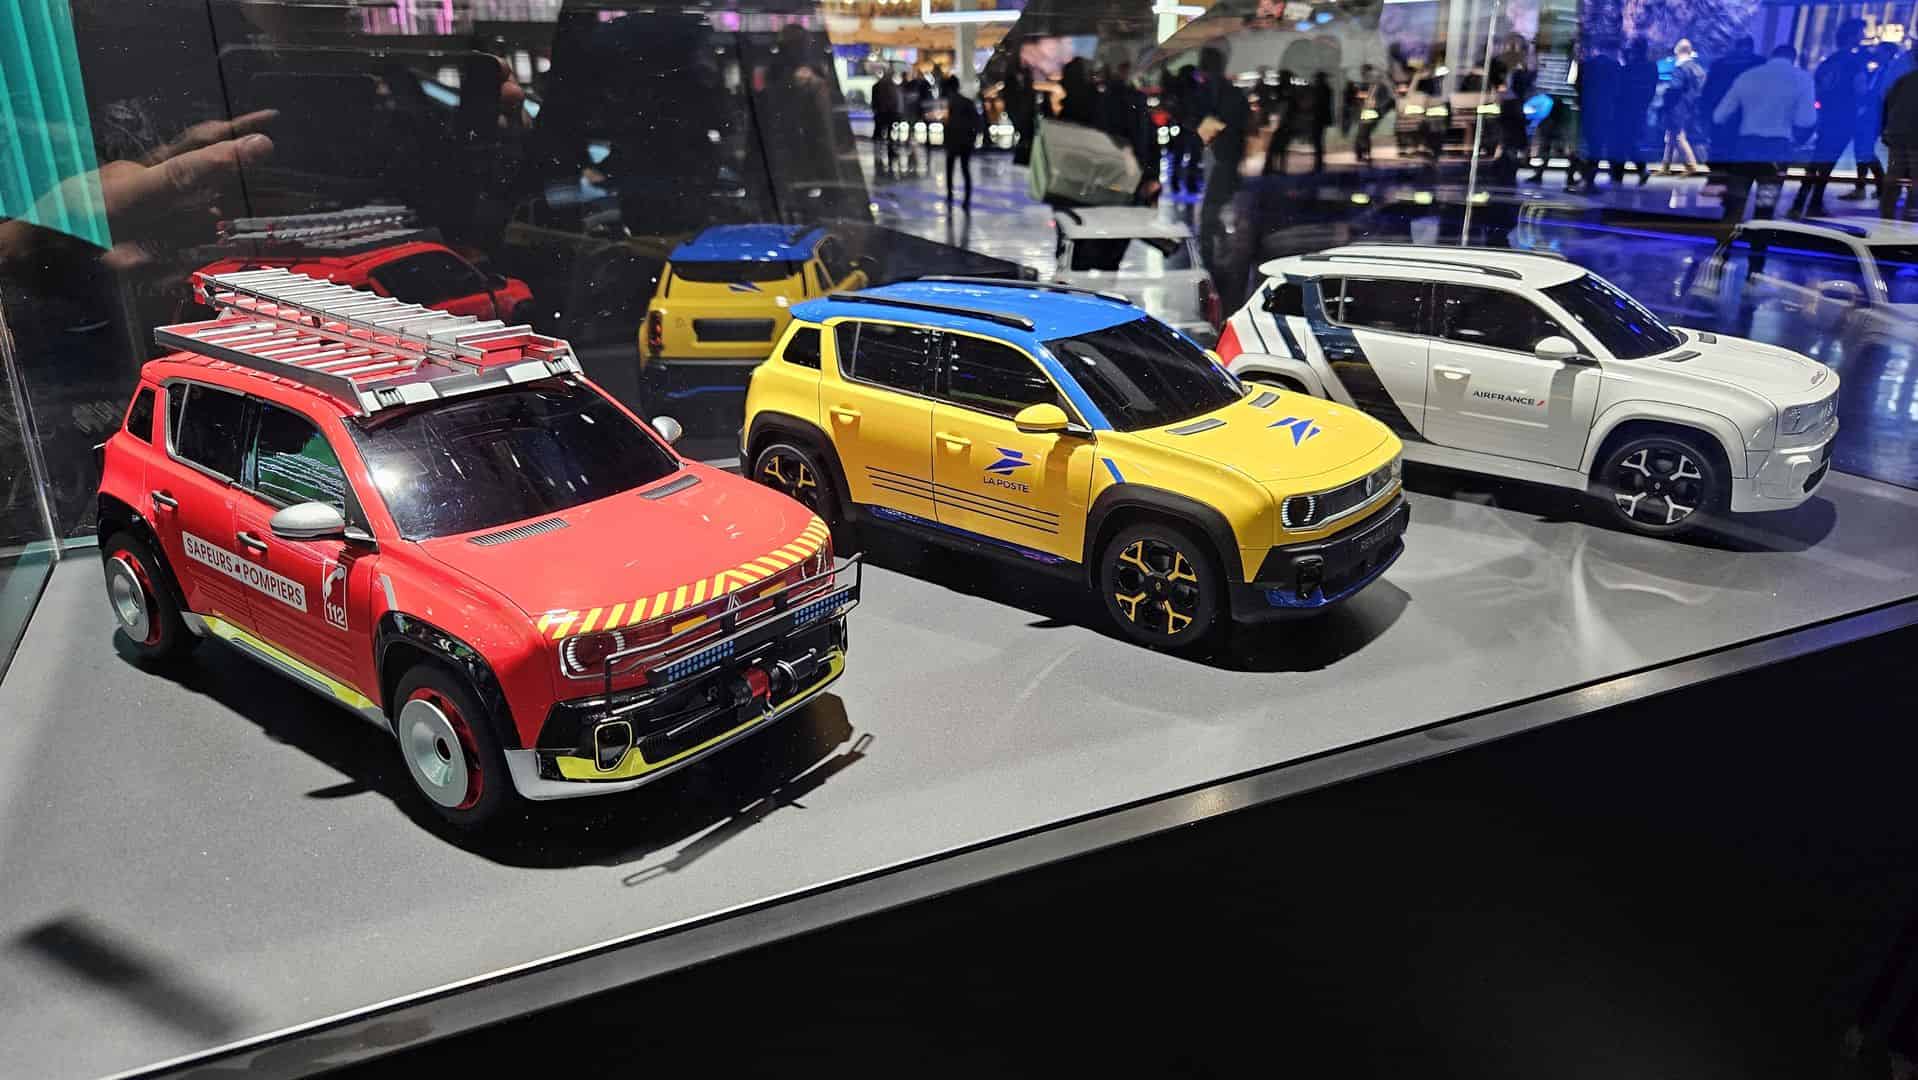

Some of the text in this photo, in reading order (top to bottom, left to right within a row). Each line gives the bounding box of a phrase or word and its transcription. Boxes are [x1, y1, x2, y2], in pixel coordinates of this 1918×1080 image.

[1473, 390, 1535, 405] AIRFRANCE
[984, 476, 1029, 493] LA POSTE
[186, 537, 303, 606] SAPEURS POMPIERS
[327, 602, 345, 626] 112
